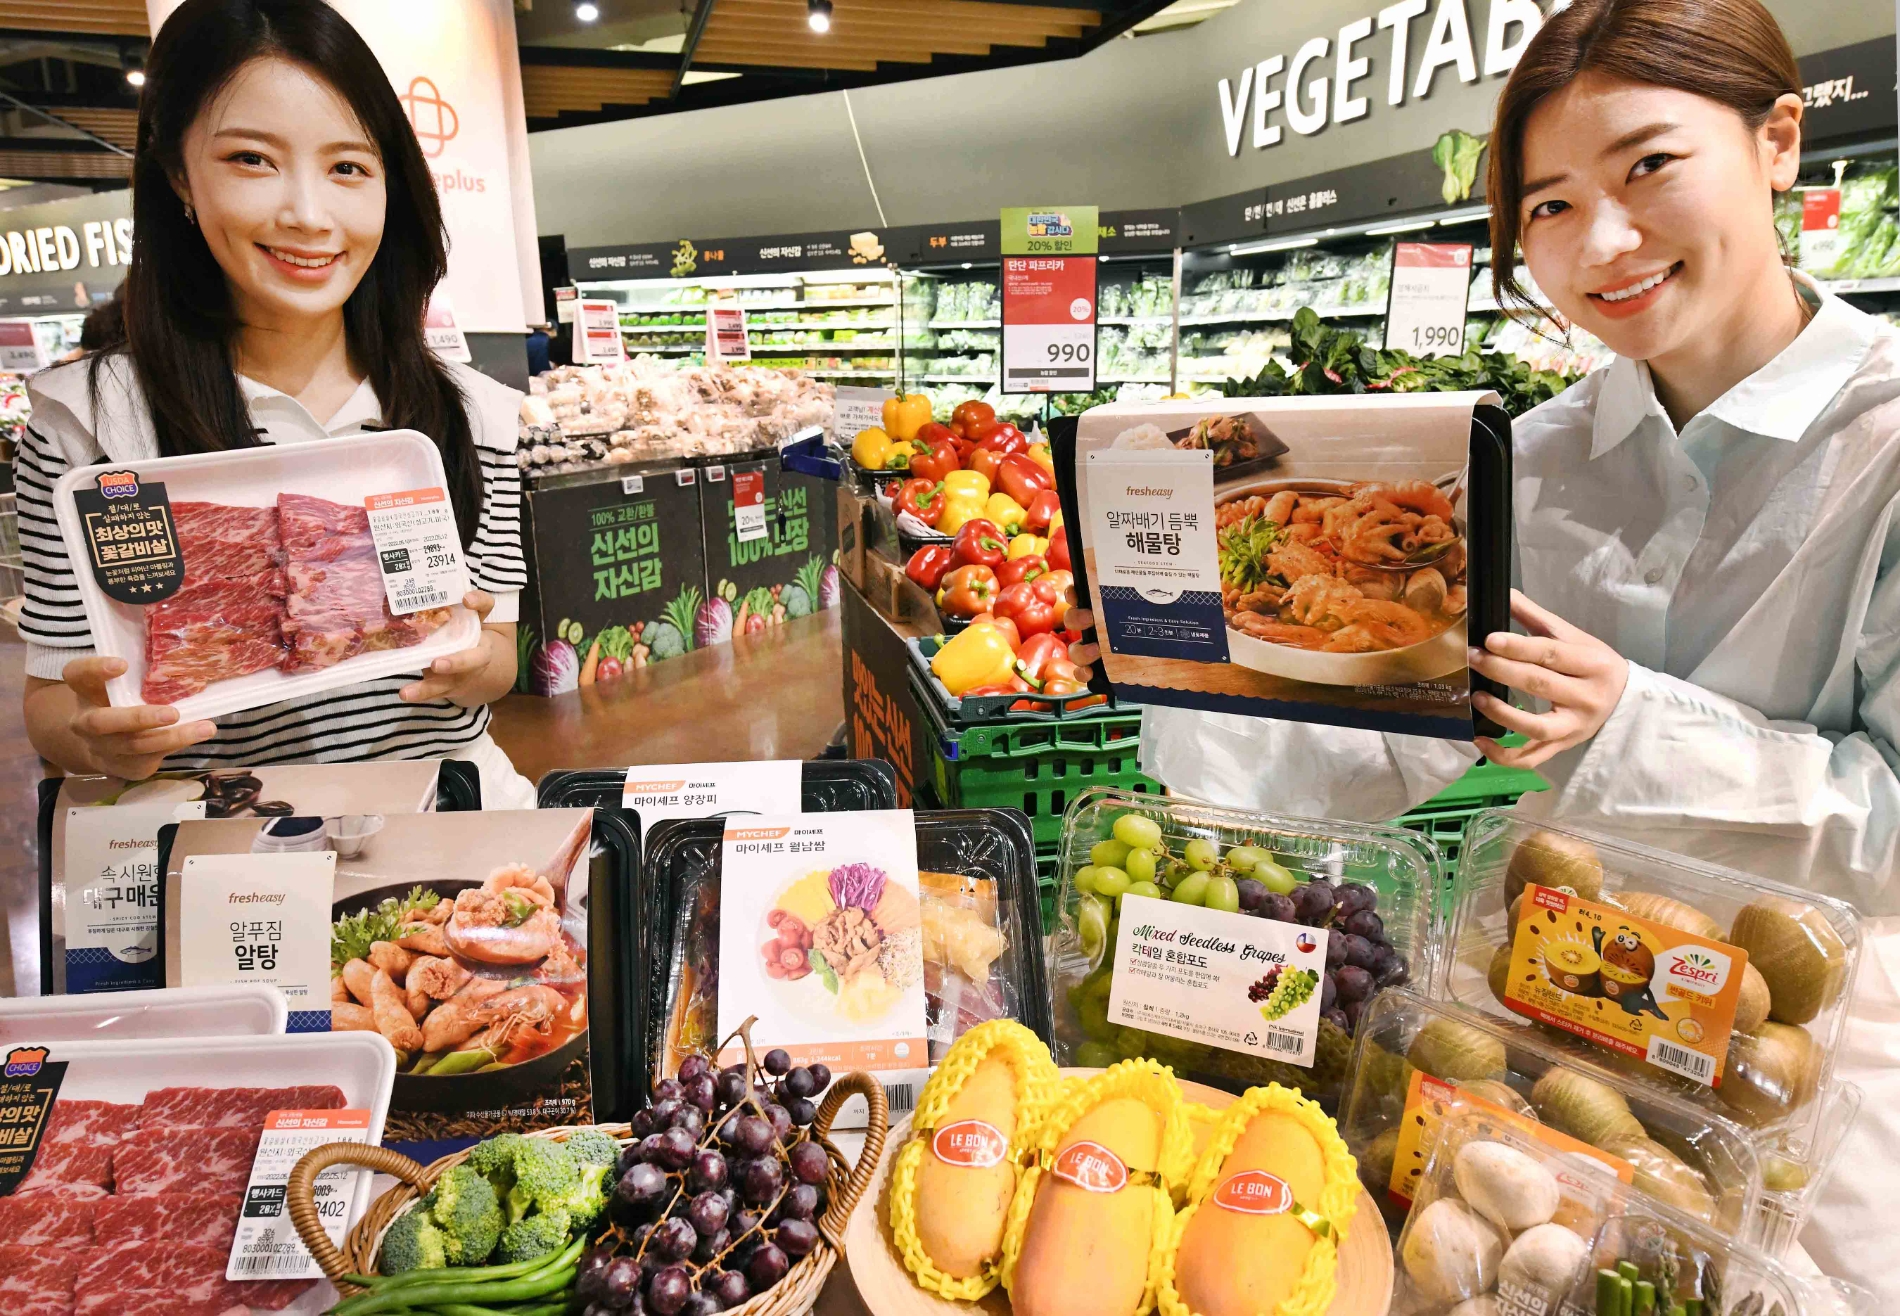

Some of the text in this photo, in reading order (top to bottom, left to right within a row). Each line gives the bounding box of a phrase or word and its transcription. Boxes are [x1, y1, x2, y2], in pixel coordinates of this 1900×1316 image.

[929, 236, 947, 248] 두부
[1027, 240, 1072, 251] 20% 할인
[760, 247, 780, 259] 신선의
[1008, 260, 1065, 271] 단단 파프리카
[1413, 326, 1459, 349] 1,990
[1047, 343, 1090, 362] 990
[106, 477, 129, 485] USDA
[105, 484, 134, 494] CHOICE
[1126, 486, 1174, 499] fresheasy
[374, 500, 393, 509] 신선의
[102, 512, 134, 524] 실패하지
[591, 503, 655, 526] 100% 교환/환불
[1106, 511, 1199, 531] 알짜배기 듬뿍
[101, 538, 168, 561] 꽃갈비살
[591, 522, 659, 566] 신선의
[1125, 532, 1181, 555] 해물탕
[427, 553, 456, 568] 23914
[593, 557, 662, 602] 자신감
[636, 783, 677, 791] MYCHEF
[634, 794, 717, 807] 마이셰프 양장피
[736, 830, 781, 838] MYCHEF
[736, 841, 826, 854] 마이셰프 월남쌈
[101, 863, 158, 883] 속 시원
[228, 892, 286, 905] fresheasy
[229, 920, 283, 942] 알푸짐
[1133, 924, 1287, 963] Mixed Seedless Grapes
[234, 943, 279, 971] 알탕
[1131, 943, 1208, 969] 칵테일 혼합포도
[1669, 956, 1719, 984] Zespri
[1696, 995, 1713, 1006] 키위
[9, 1062, 37, 1072] CHOICE
[275, 1117, 328, 1128] 신선의 자신감
[950, 1133, 989, 1149] LE BON
[1069, 1151, 1110, 1174] LE BON
[251, 1187, 285, 1199] 행사카드
[1231, 1182, 1245, 1194] LE
[1247, 1182, 1273, 1198] BON
[259, 1204, 275, 1215] 20%
[263, 1228, 276, 1236] 326
